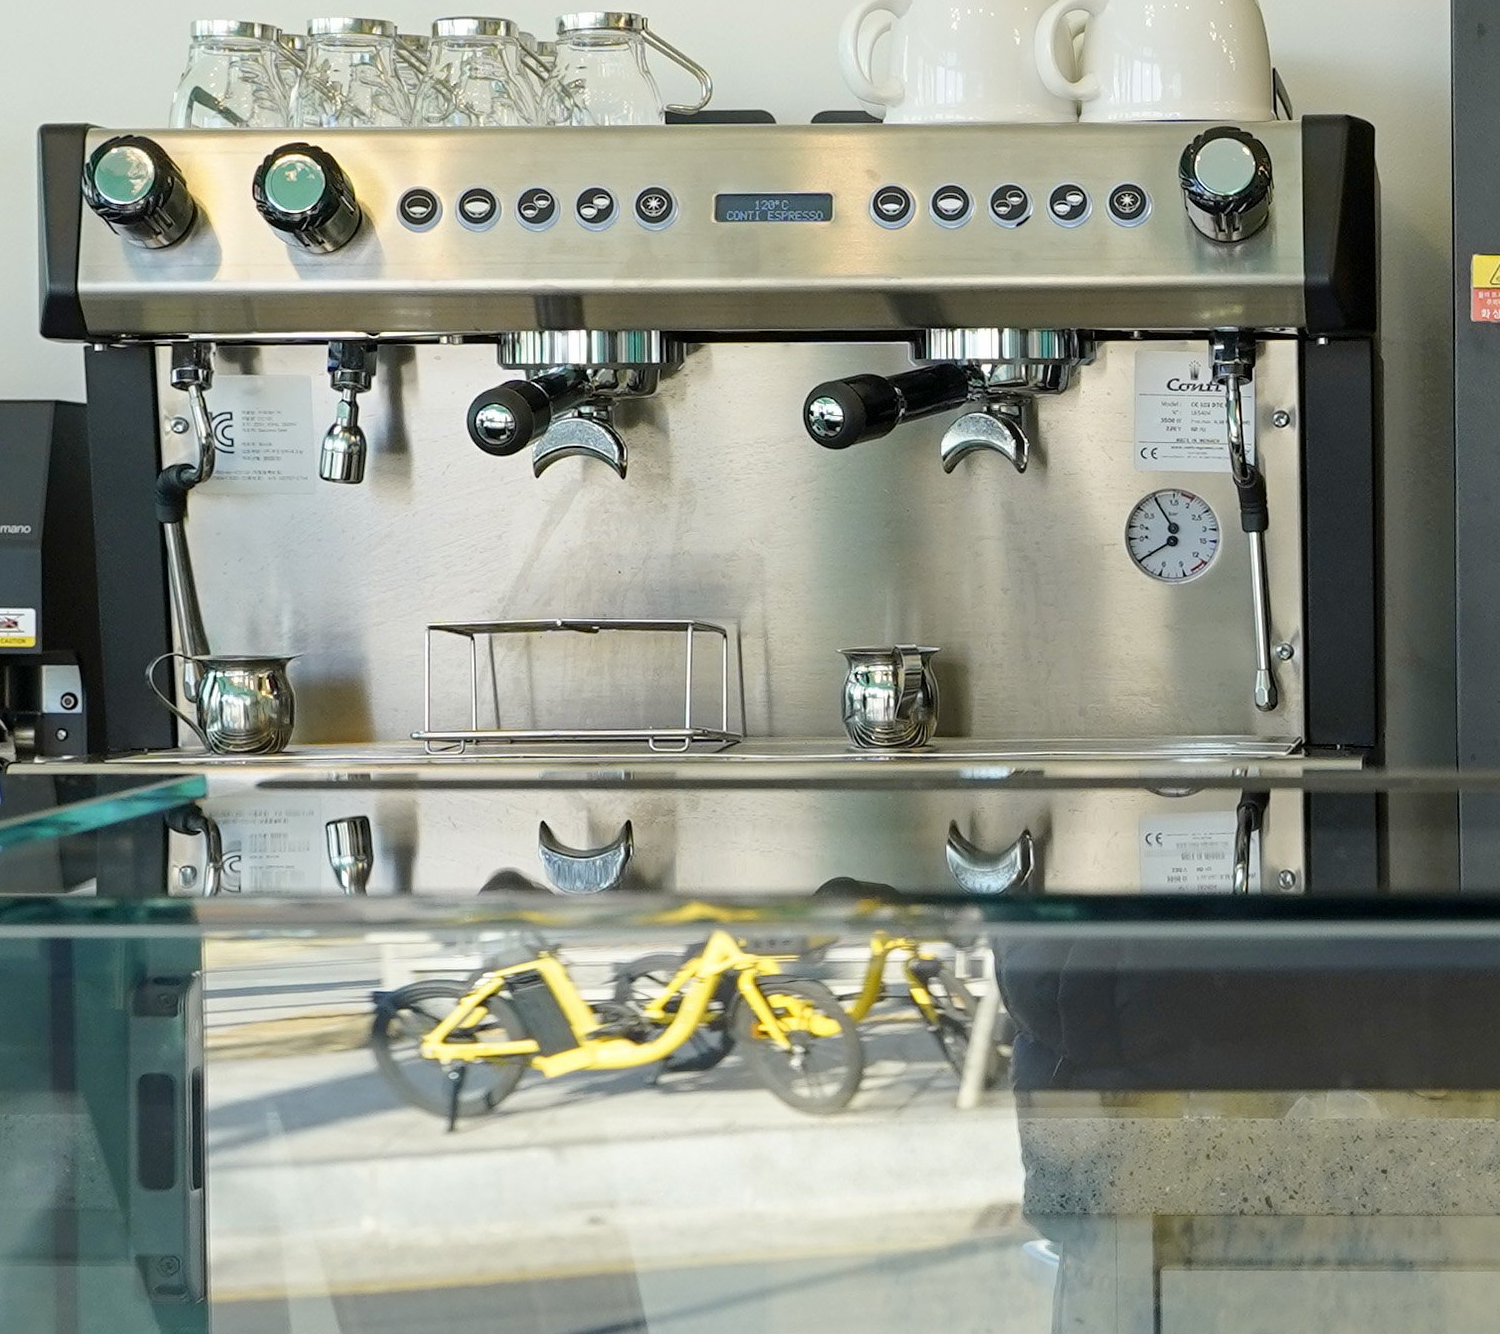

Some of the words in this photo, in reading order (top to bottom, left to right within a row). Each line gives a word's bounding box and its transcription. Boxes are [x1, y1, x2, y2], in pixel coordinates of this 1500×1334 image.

[726, 210, 760, 221] CONTI
[767, 210, 823, 221] ESPRESSO
[0, 524, 32, 534] mano
